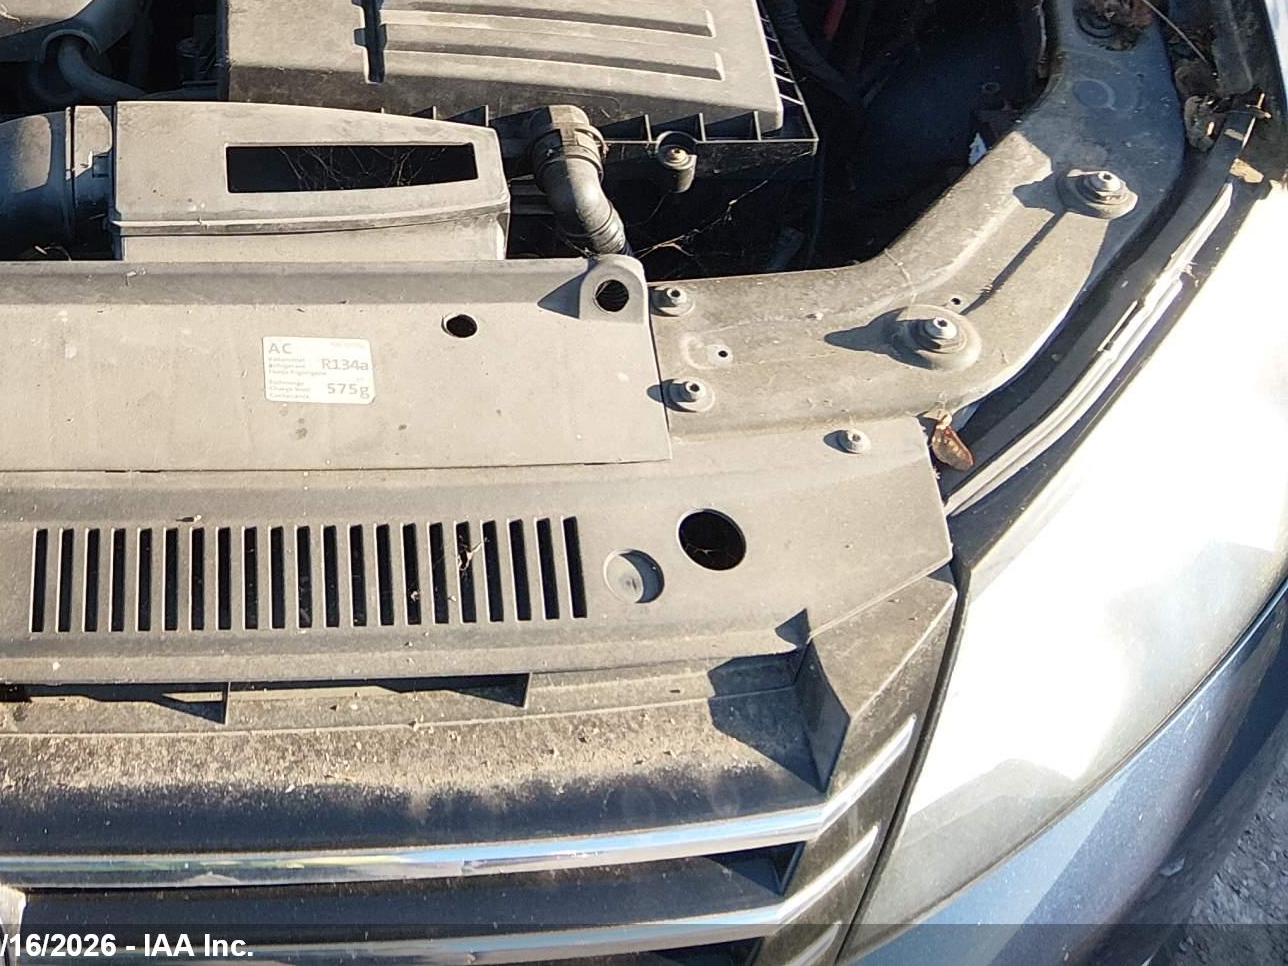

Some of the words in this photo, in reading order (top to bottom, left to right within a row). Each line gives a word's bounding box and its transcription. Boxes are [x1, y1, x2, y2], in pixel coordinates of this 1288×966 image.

[268, 342, 293, 355] AC
[321, 357, 369, 371] R134a
[327, 382, 370, 400] 575g
